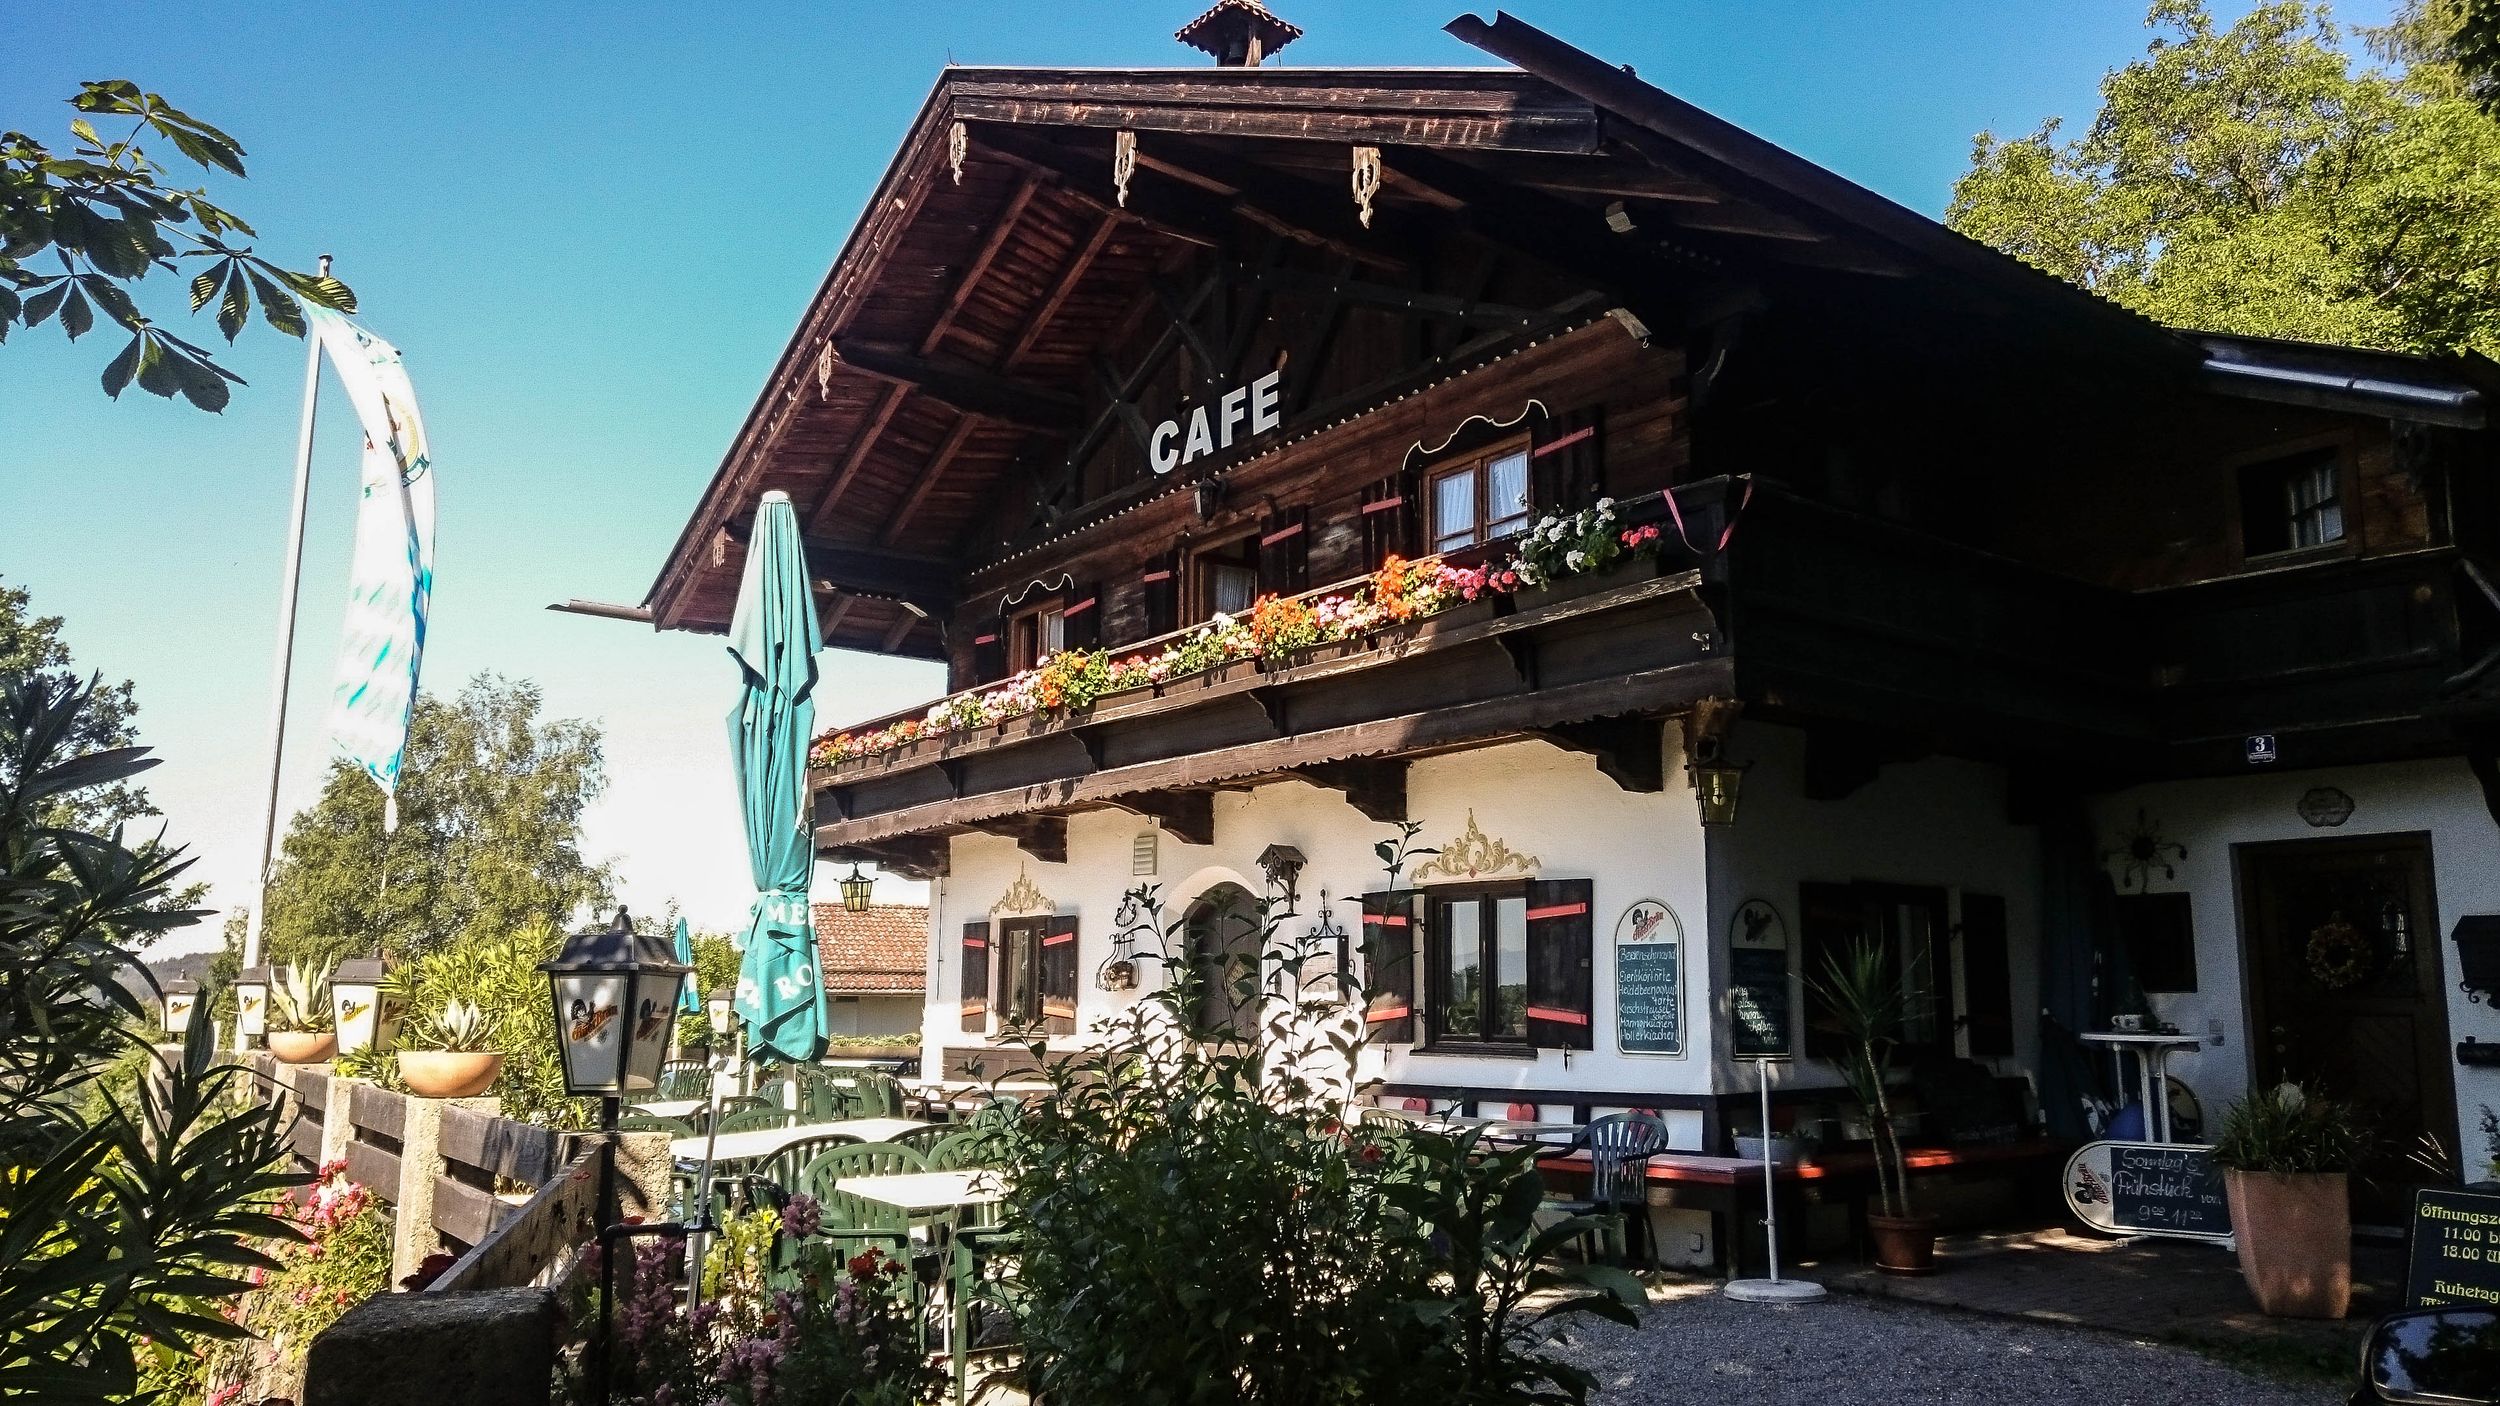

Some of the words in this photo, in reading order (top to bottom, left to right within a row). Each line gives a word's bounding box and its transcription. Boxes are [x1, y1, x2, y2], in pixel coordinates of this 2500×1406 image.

[1150, 370, 1280, 474] CAFE
[2255, 737, 2265, 752] 3
[2113, 1170, 2194, 1199] Frühstück
[2421, 1203, 2500, 1226] Öffnungsz
[2443, 1226, 2481, 1241] 11.00
[2442, 1245, 2480, 1260] 18.00
